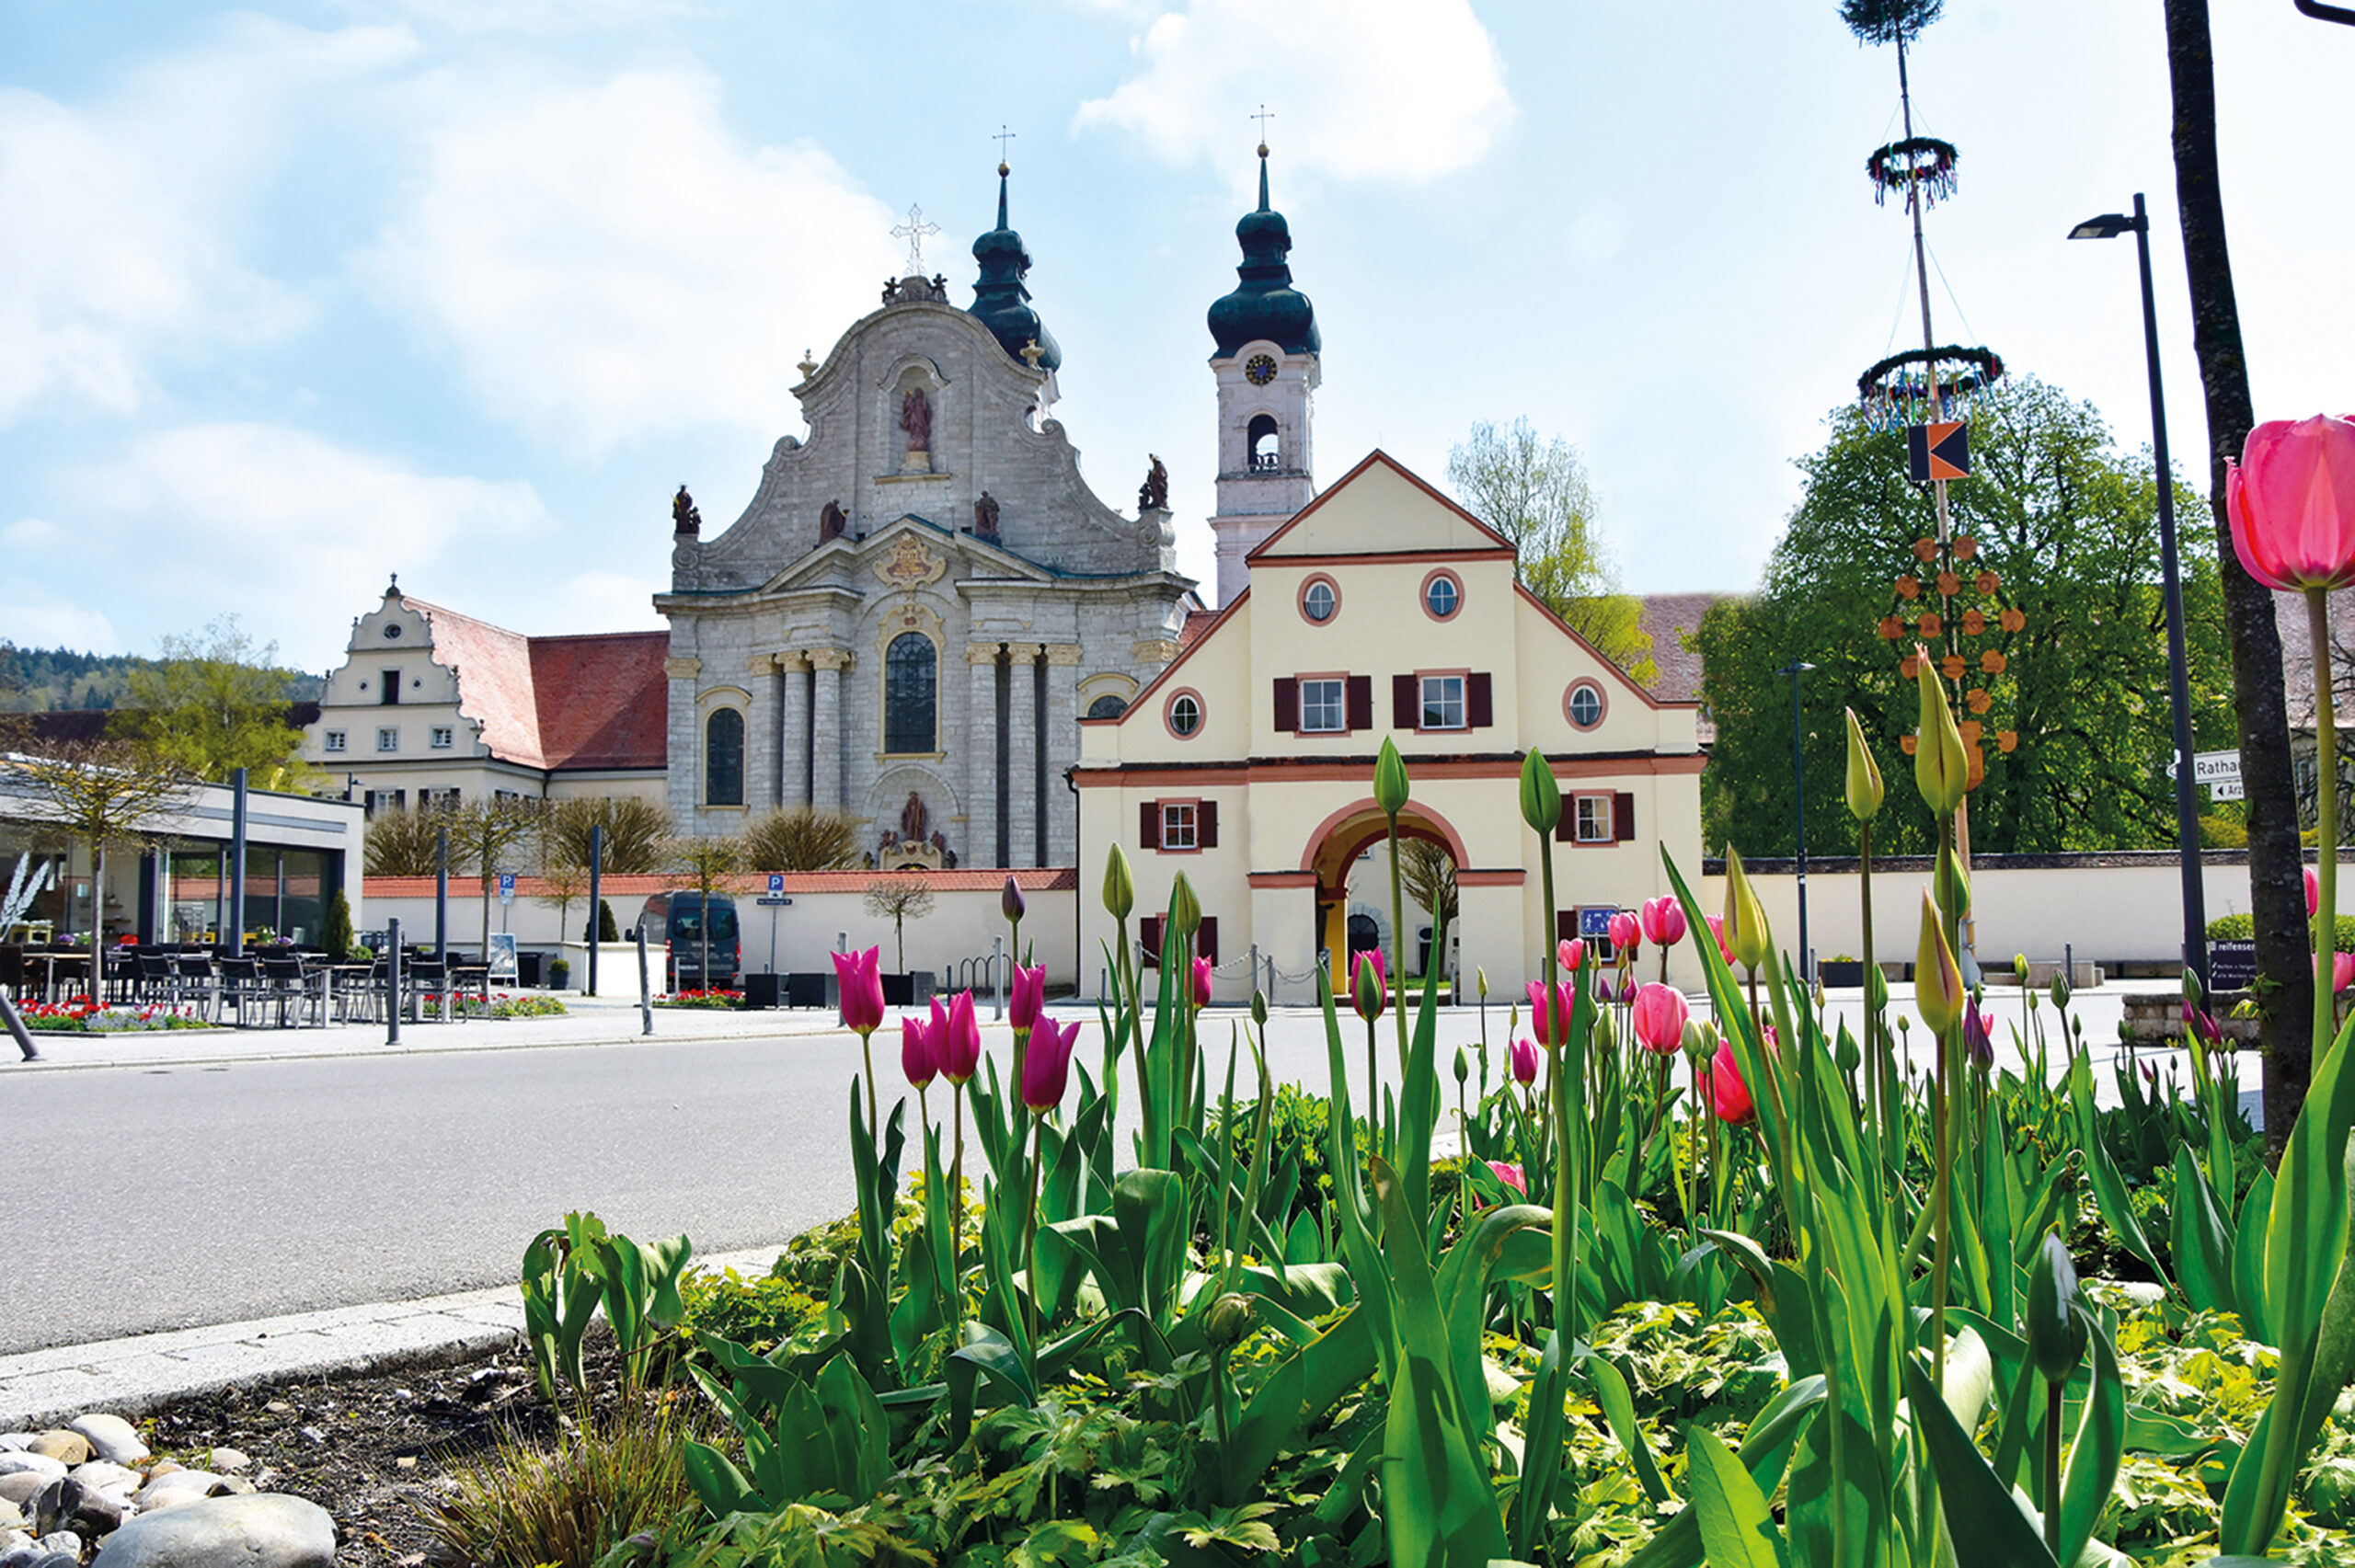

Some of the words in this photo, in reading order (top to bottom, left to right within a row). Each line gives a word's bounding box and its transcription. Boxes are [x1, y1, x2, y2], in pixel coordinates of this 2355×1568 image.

[2196, 760, 2241, 775] Ratha
[503, 876, 512, 887] P
[771, 876, 781, 888] P
